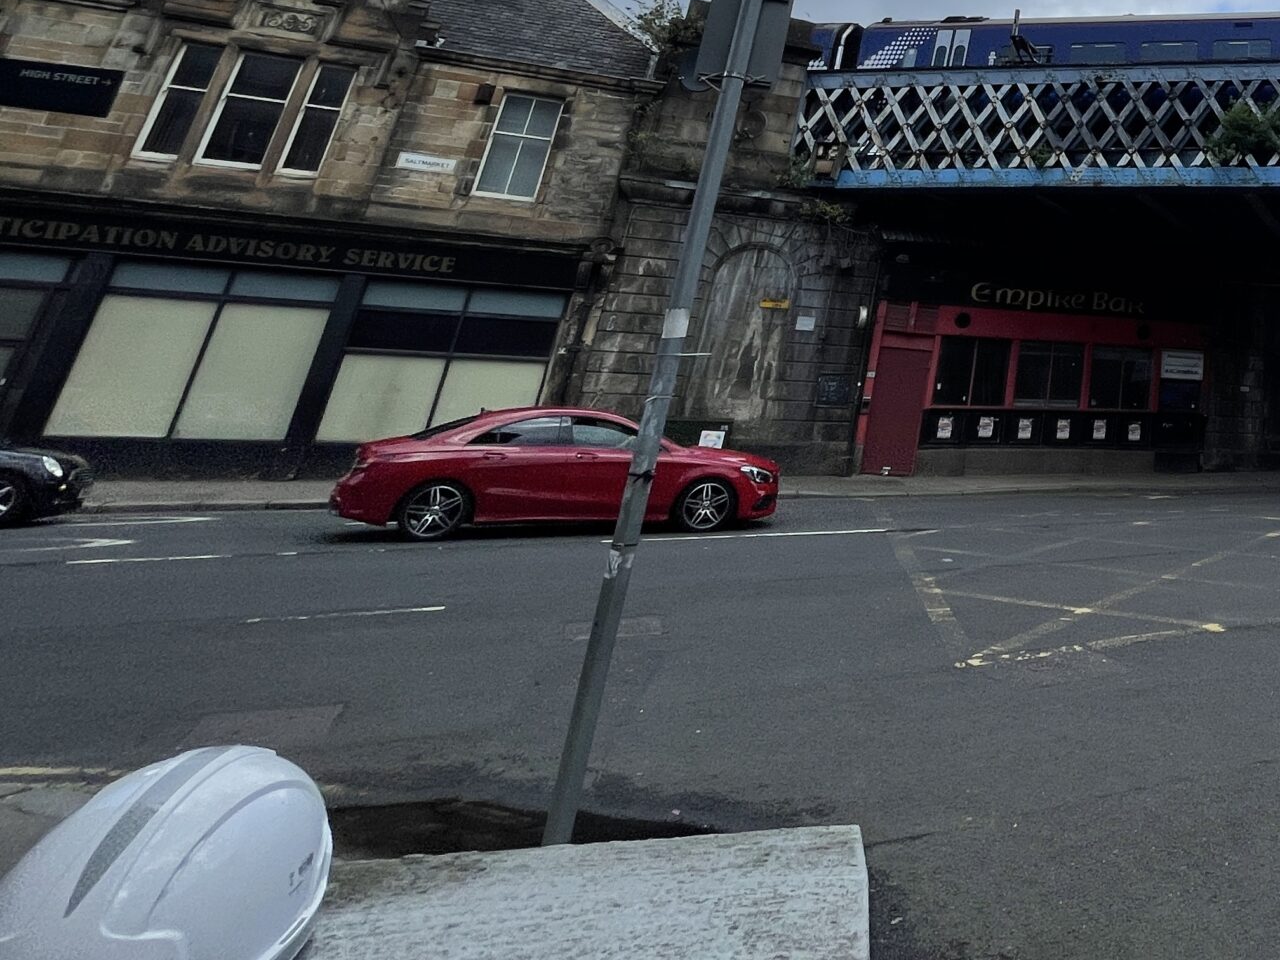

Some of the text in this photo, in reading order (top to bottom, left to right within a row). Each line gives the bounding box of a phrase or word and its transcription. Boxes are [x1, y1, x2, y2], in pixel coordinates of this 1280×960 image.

[19, 69, 101, 86] HIGH STREET
[405, 157, 450, 169] SALTMARKET
[184, 234, 337, 264] ADVISORY
[342, 247, 457, 274] SERVICE
[1092, 290, 1145, 314] Bar
